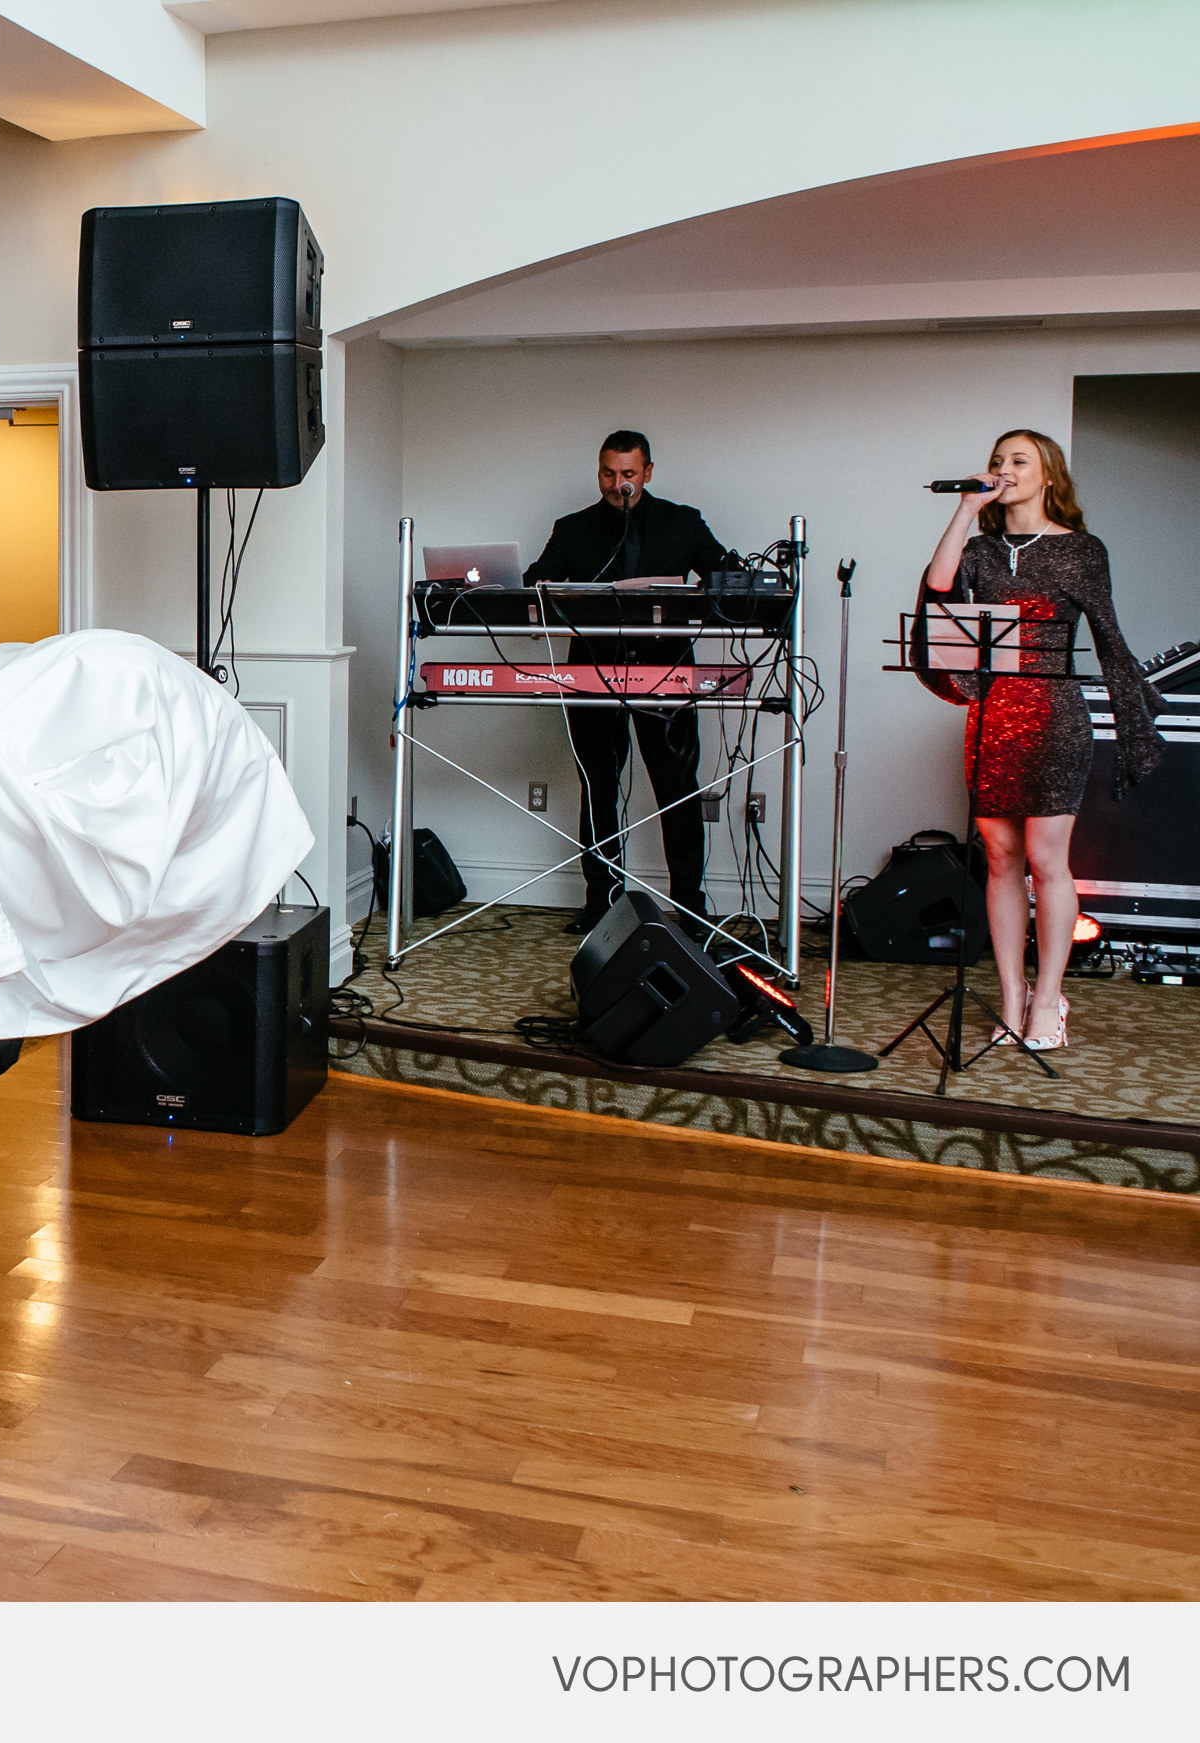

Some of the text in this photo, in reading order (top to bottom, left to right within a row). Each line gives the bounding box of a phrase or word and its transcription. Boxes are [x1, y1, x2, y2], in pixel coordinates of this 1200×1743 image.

[443, 669, 493, 686] KORG
[515, 673, 574, 682] KARMA
[156, 1094, 185, 1103] QSC
